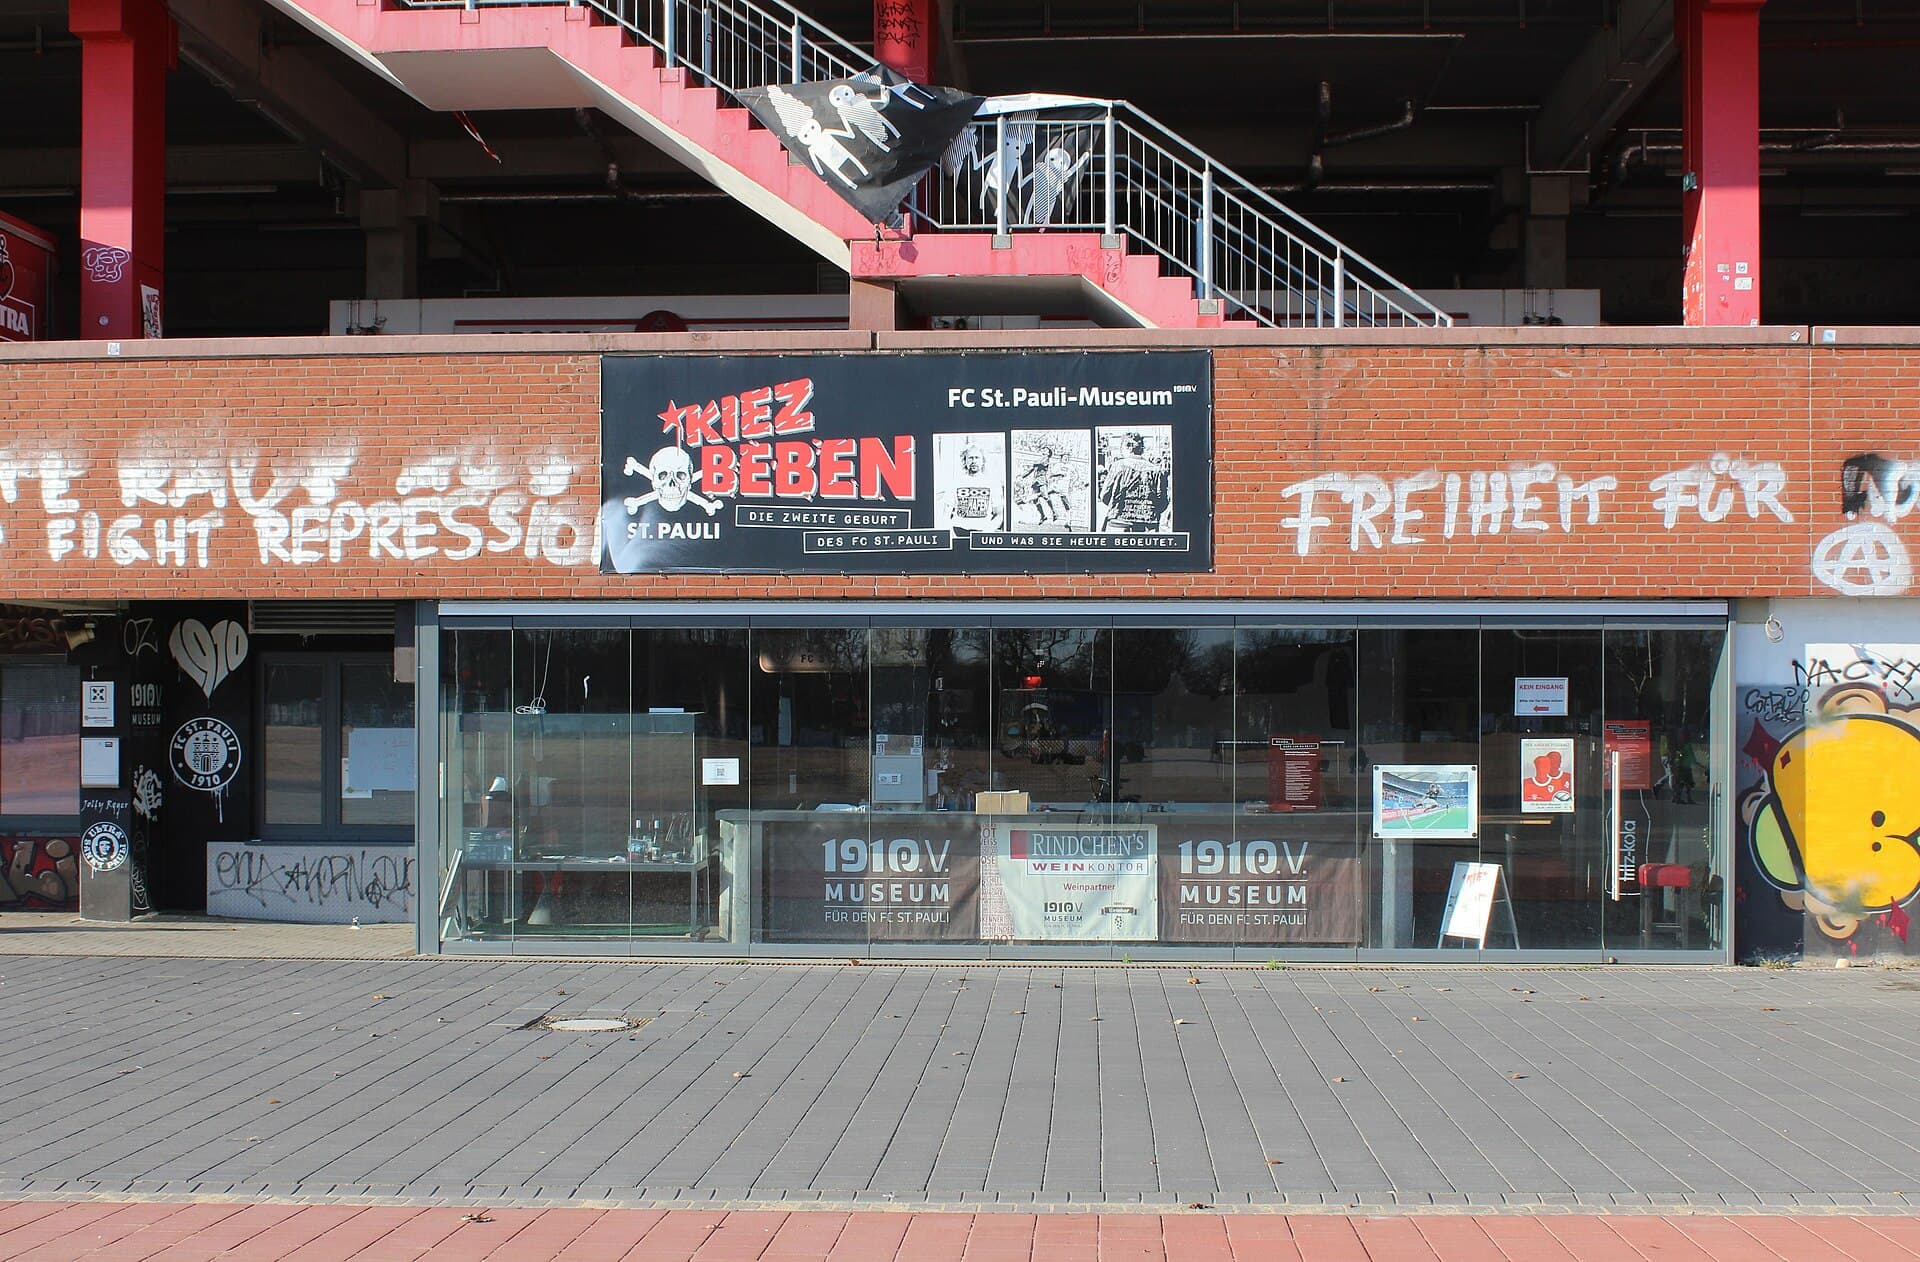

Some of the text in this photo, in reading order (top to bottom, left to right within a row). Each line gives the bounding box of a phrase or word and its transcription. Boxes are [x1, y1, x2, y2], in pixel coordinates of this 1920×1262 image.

[948, 388, 976, 408] FC
[682, 377, 815, 447] KIEZ
[701, 435, 916, 501] BEBEN
[1280, 462, 1618, 557] FREIHEIT
[1649, 453, 1795, 531] FÜR
[749, 511, 898, 526] DIE ZWEITE GEBURT
[46, 492, 600, 568] FIGHT REPRESSIO
[817, 536, 844, 548] DES
[852, 536, 868, 547] FC
[981, 536, 1178, 548] UND WAS SIE HEUTE BEDEUTET.
[131, 713, 161, 726] MUSEUM
[173, 735, 187, 750] FC
[207, 721, 238, 751] PAULI
[190, 773, 221, 787] 1910
[825, 883, 950, 902] MUSEUM
[1063, 882, 1116, 893] Weinpartner
[1181, 885, 1307, 904] MUSEUM
[825, 909, 849, 923] FÜR
[853, 911, 876, 923] DEN
[880, 911, 894, 923] FC
[1180, 911, 1205, 925] FÜR
[1209, 913, 1233, 925] DEN
[1237, 913, 1250, 925] FC
